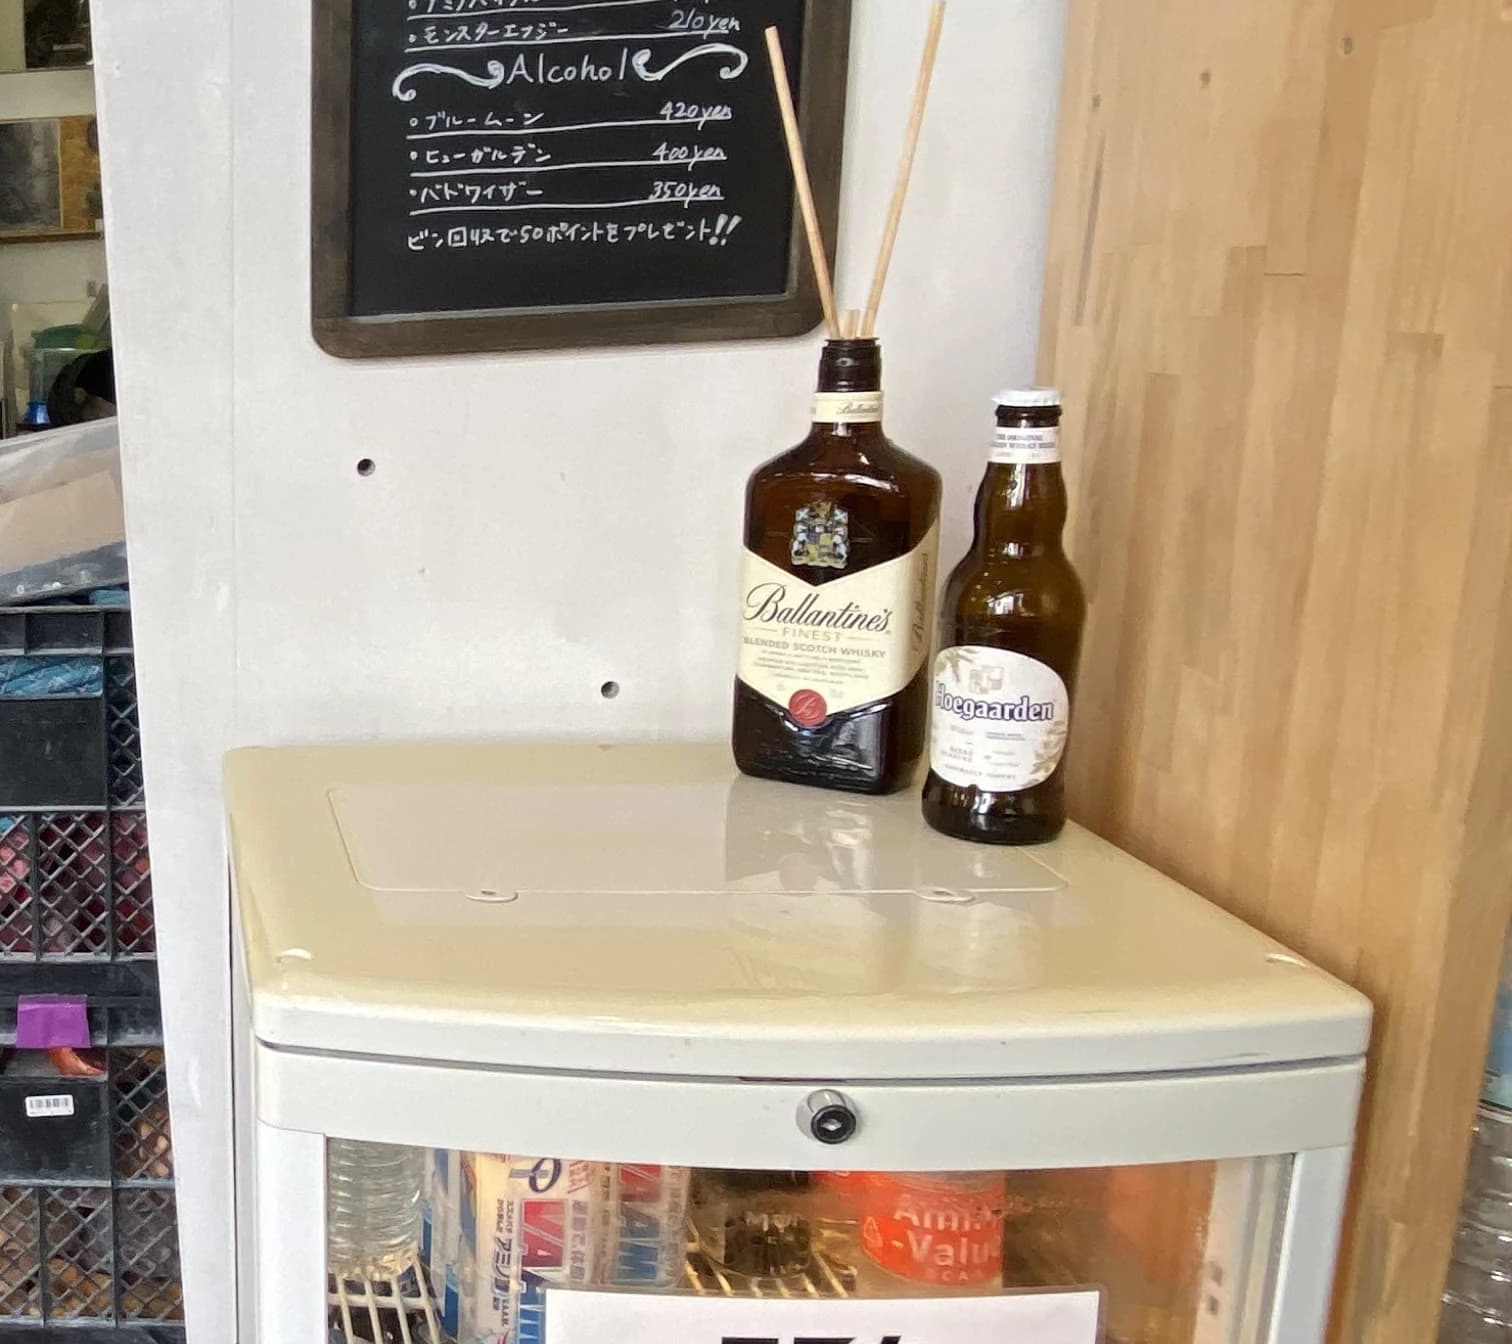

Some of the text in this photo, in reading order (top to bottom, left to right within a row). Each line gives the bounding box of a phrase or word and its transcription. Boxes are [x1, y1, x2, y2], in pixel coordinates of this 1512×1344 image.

[668, 10, 741, 39] 210yen
[506, 48, 628, 84] Alcohol
[659, 102, 732, 131] 420yen
[425, 142, 726, 171] ヒューガルデン 400yen
[648, 181, 724, 208] 350yen
[742, 582, 893, 633] Ballantine's
[743, 637, 887, 659] BLENDED SCOTCH WHISKY
[782, 627, 842, 642] FINEST
[935, 682, 1054, 721] Hoegaarden
